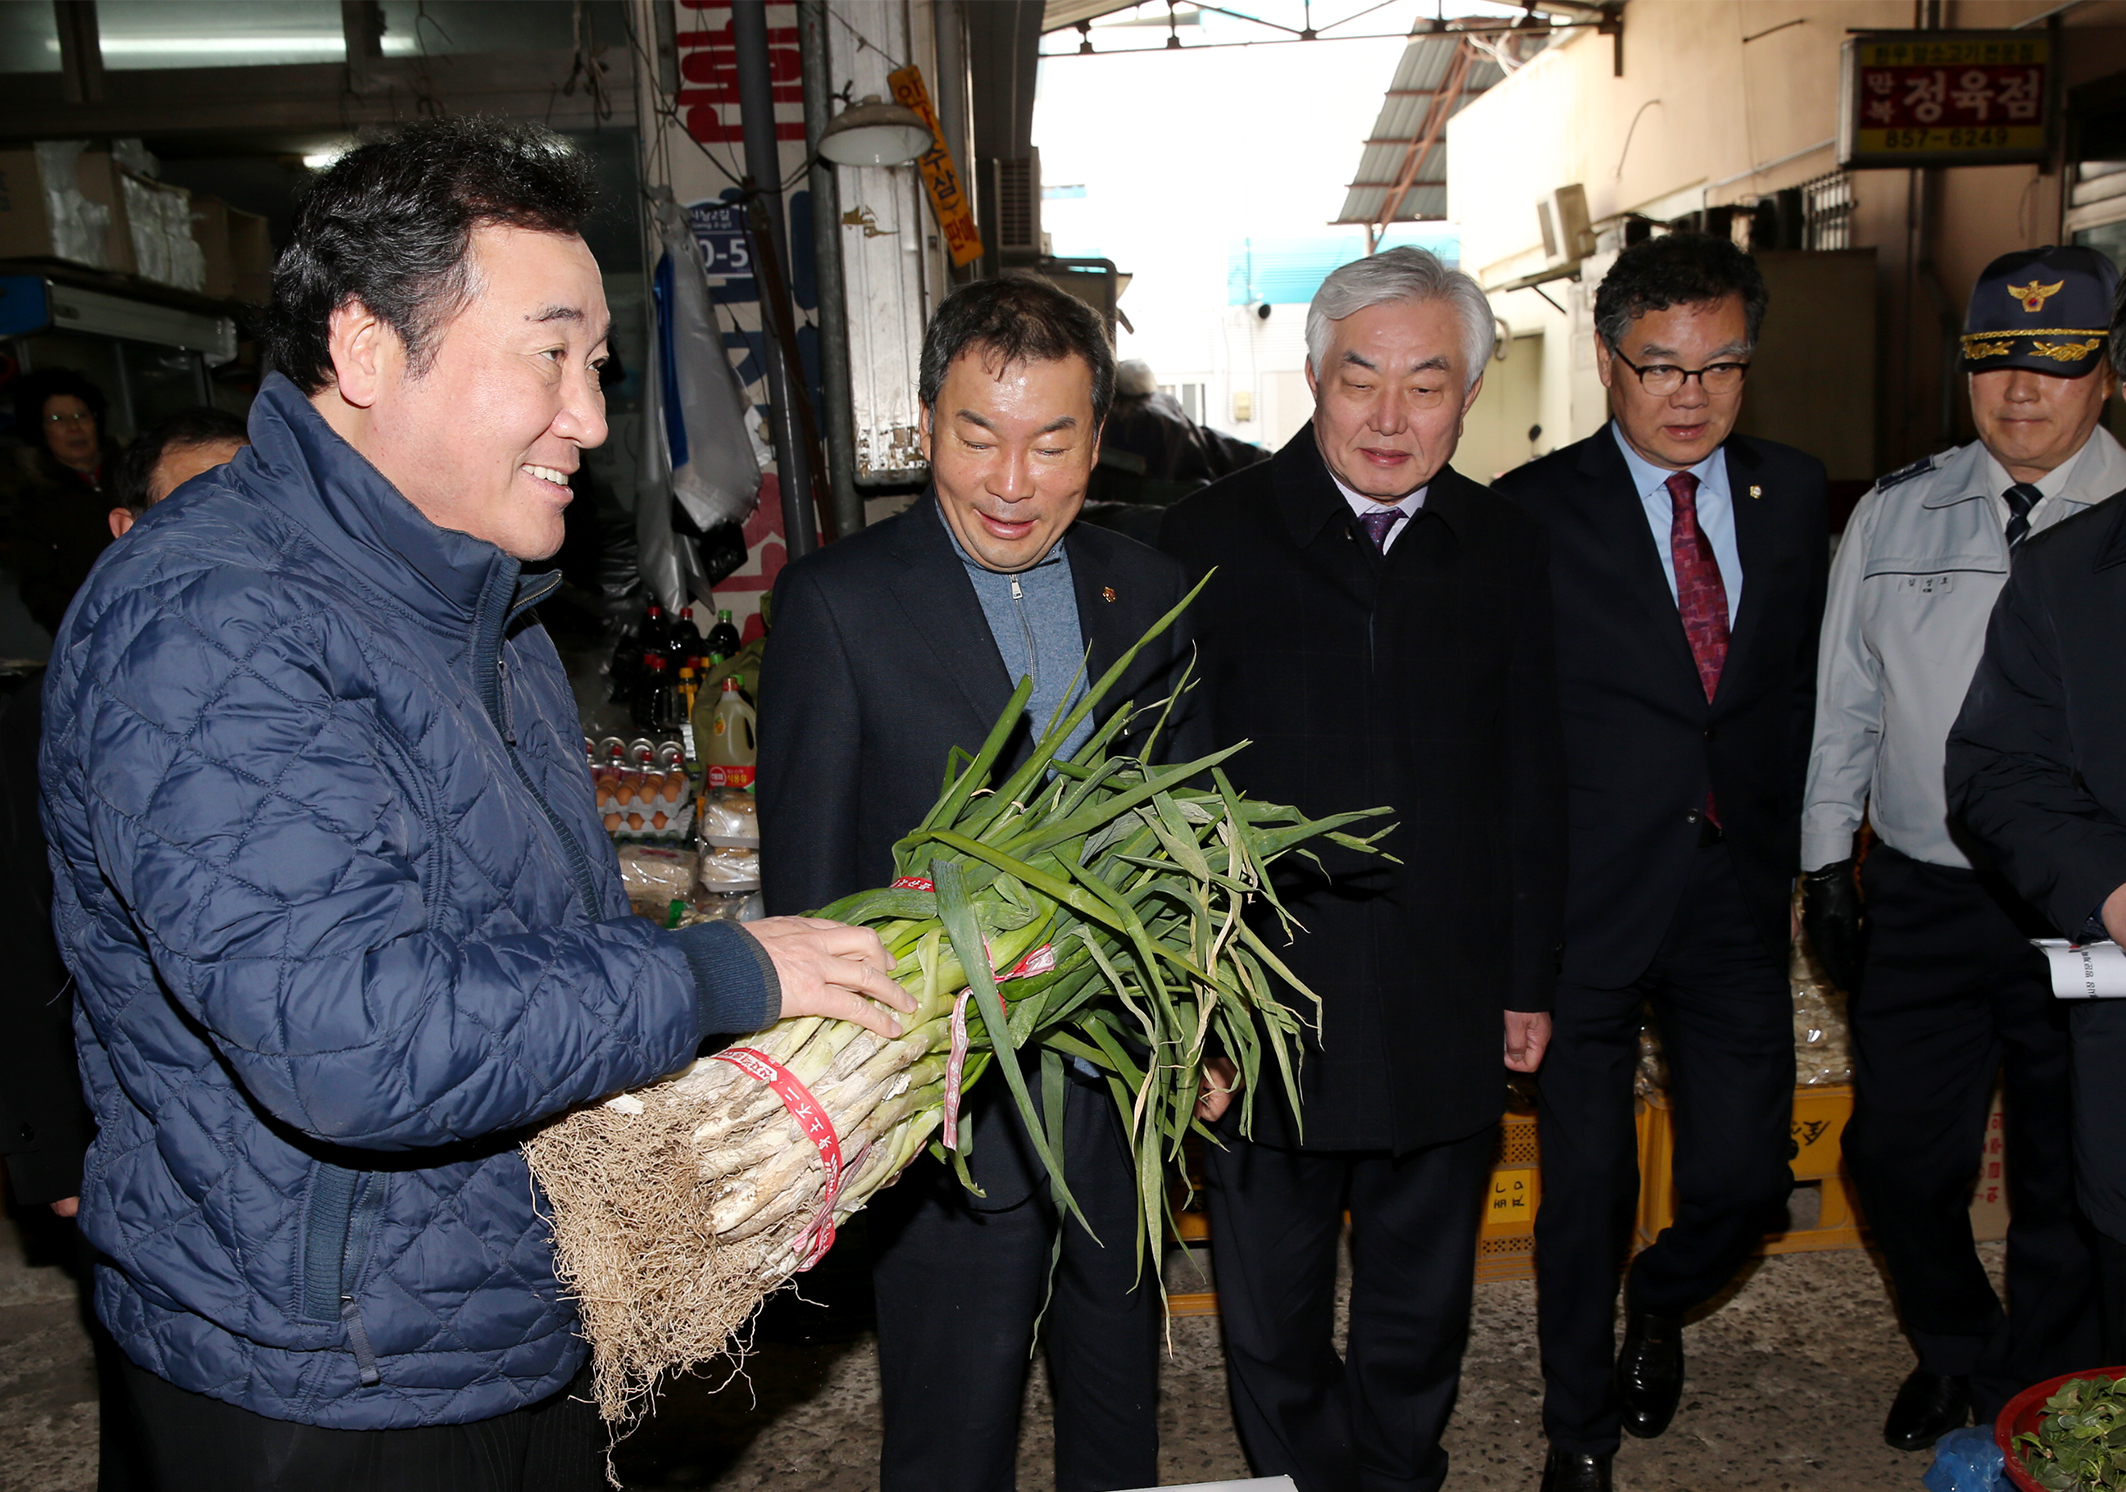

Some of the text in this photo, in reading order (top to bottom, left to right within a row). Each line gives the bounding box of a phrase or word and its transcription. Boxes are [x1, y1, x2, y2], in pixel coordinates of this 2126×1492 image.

[1901, 67, 2041, 125] 정육점
[1885, 127, 2008, 149] 857-6249
[784, 1086, 832, 1150] 身土不二
